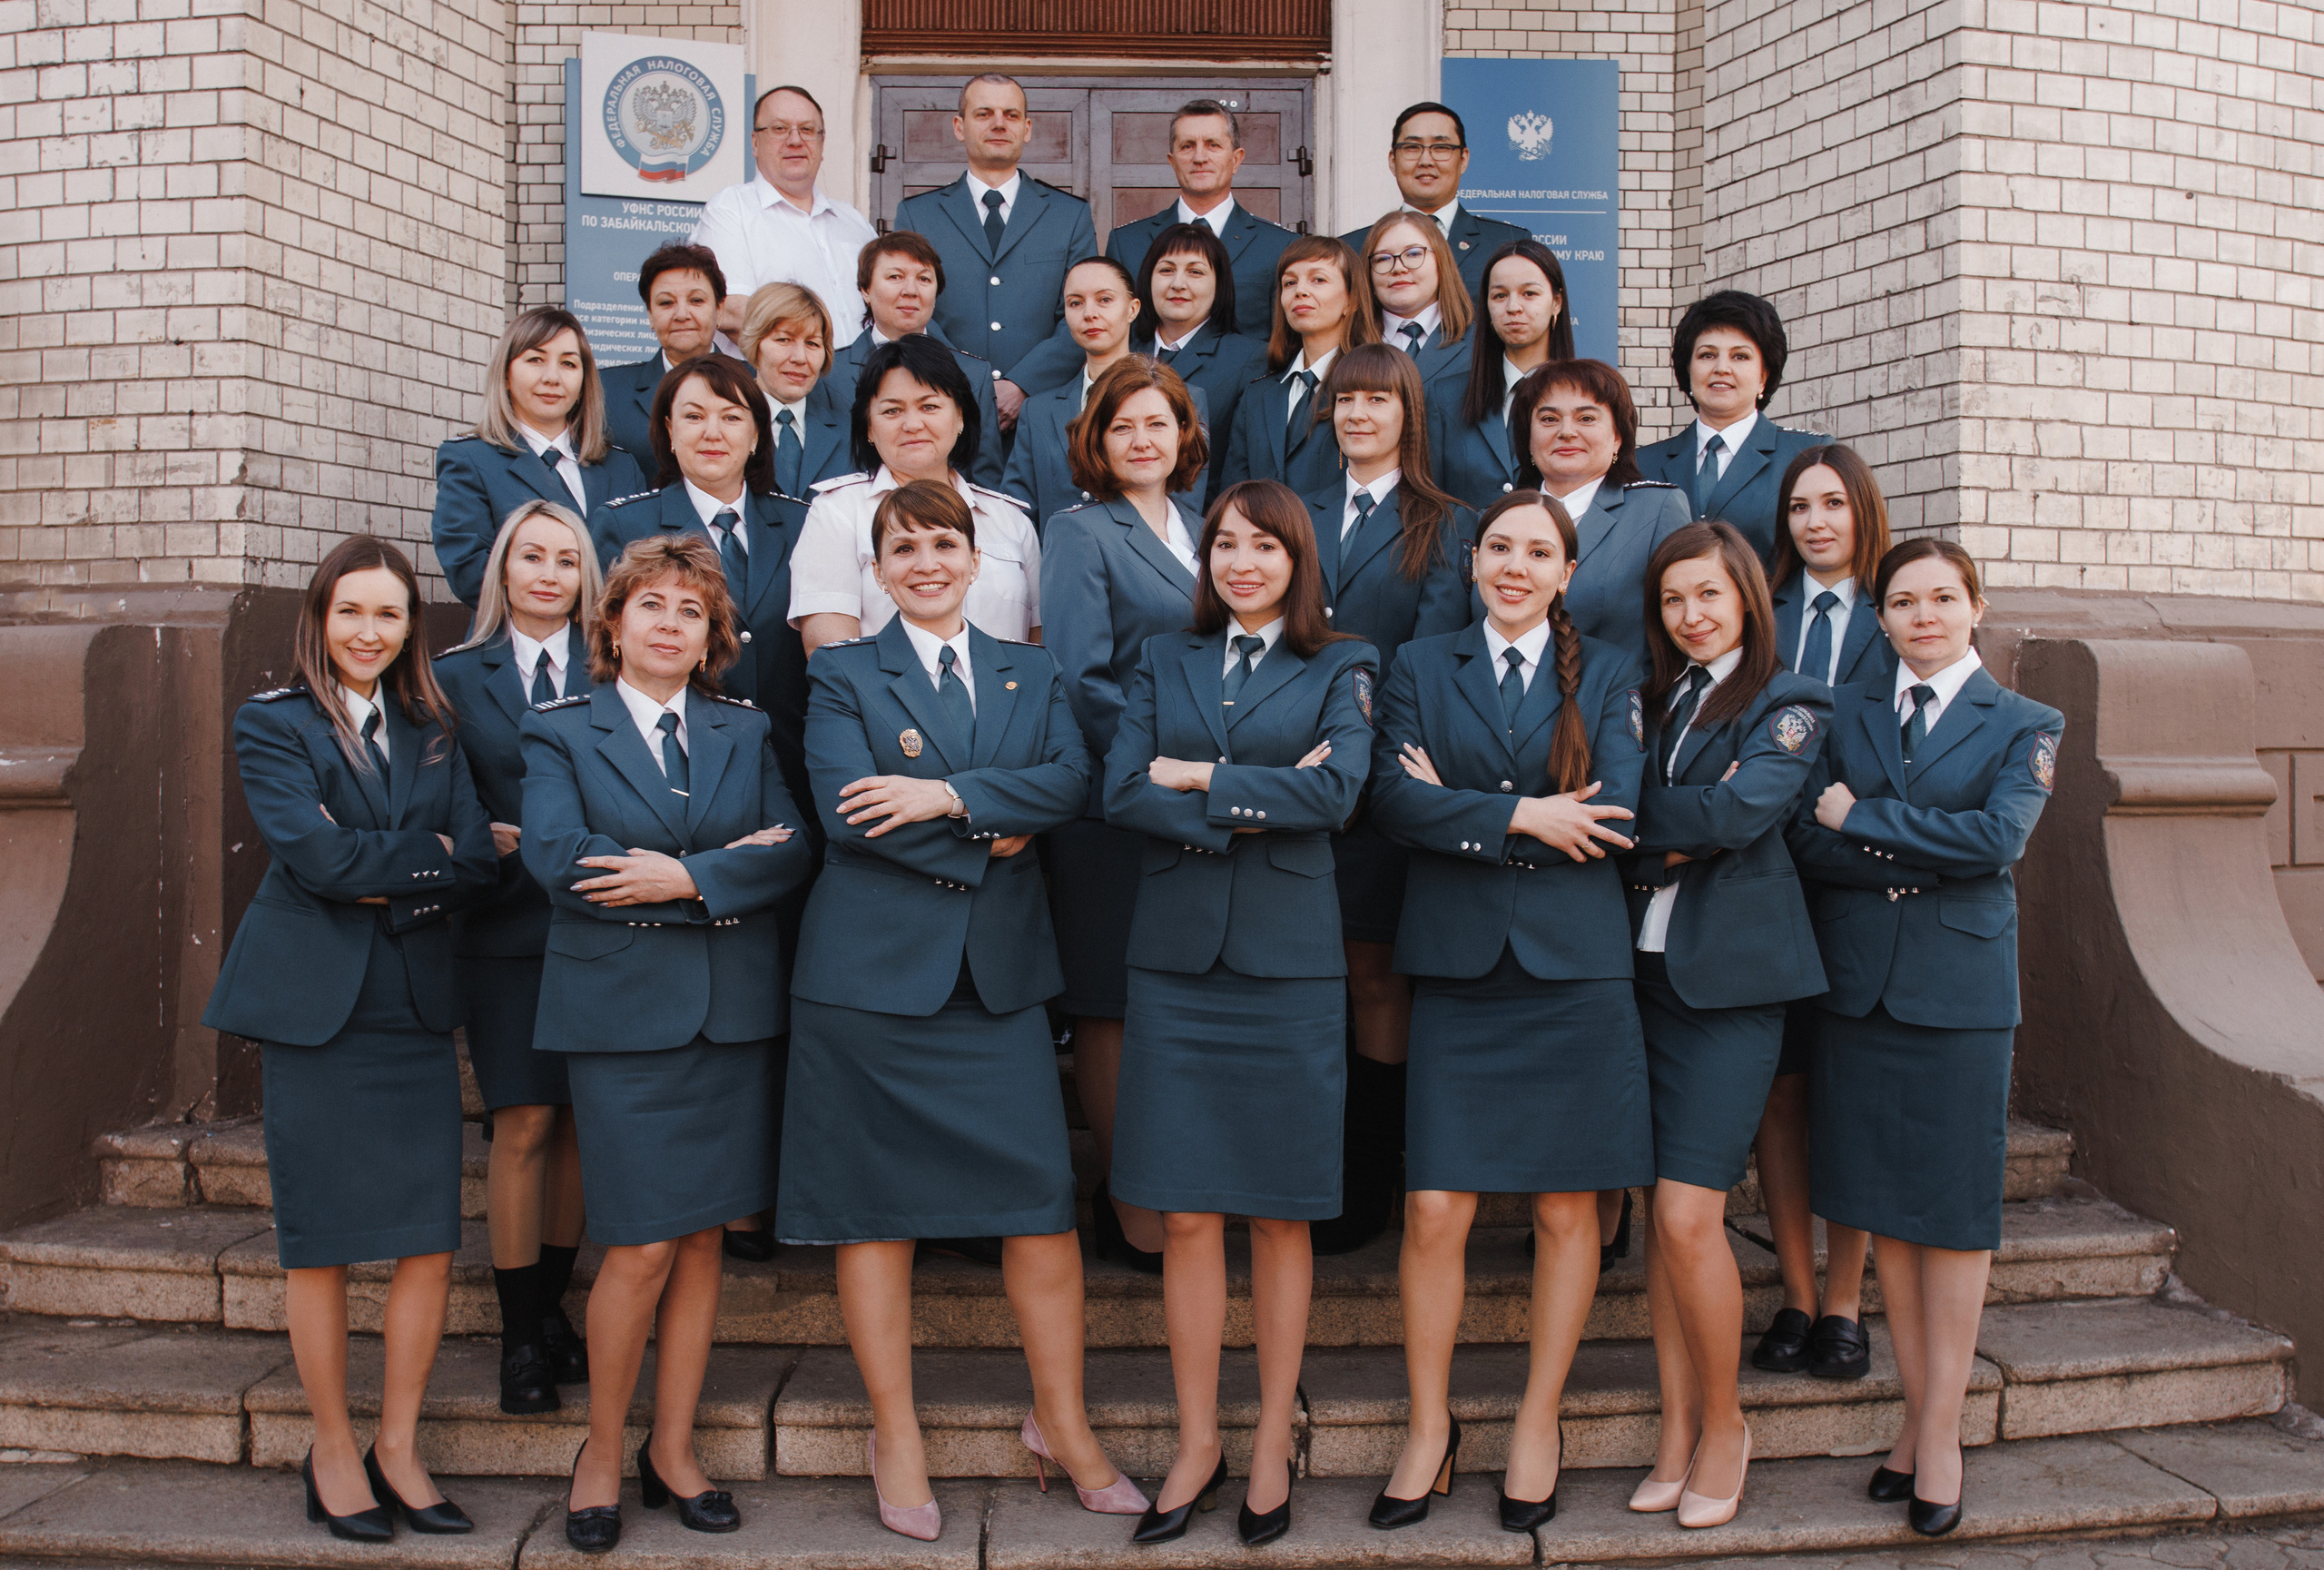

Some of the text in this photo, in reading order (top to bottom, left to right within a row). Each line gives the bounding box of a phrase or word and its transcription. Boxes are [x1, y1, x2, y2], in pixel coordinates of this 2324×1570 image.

[606, 60, 722, 156] ФЕДЕРАЛЬНАЯ НАЛОГОВАЯ СЛУЖБА
[1518, 190, 1570, 200] НАЛОГОВАЯ
[1571, 191, 1609, 200] СЛУЖБА
[622, 202, 702, 218] УФНС РОССИИ
[581, 214, 597, 226] ПО
[1532, 234, 1567, 245] ОССИИ
[1574, 250, 1605, 261] КРАЮ
[574, 299, 645, 313] Подразделение
[591, 314, 637, 326] категории
